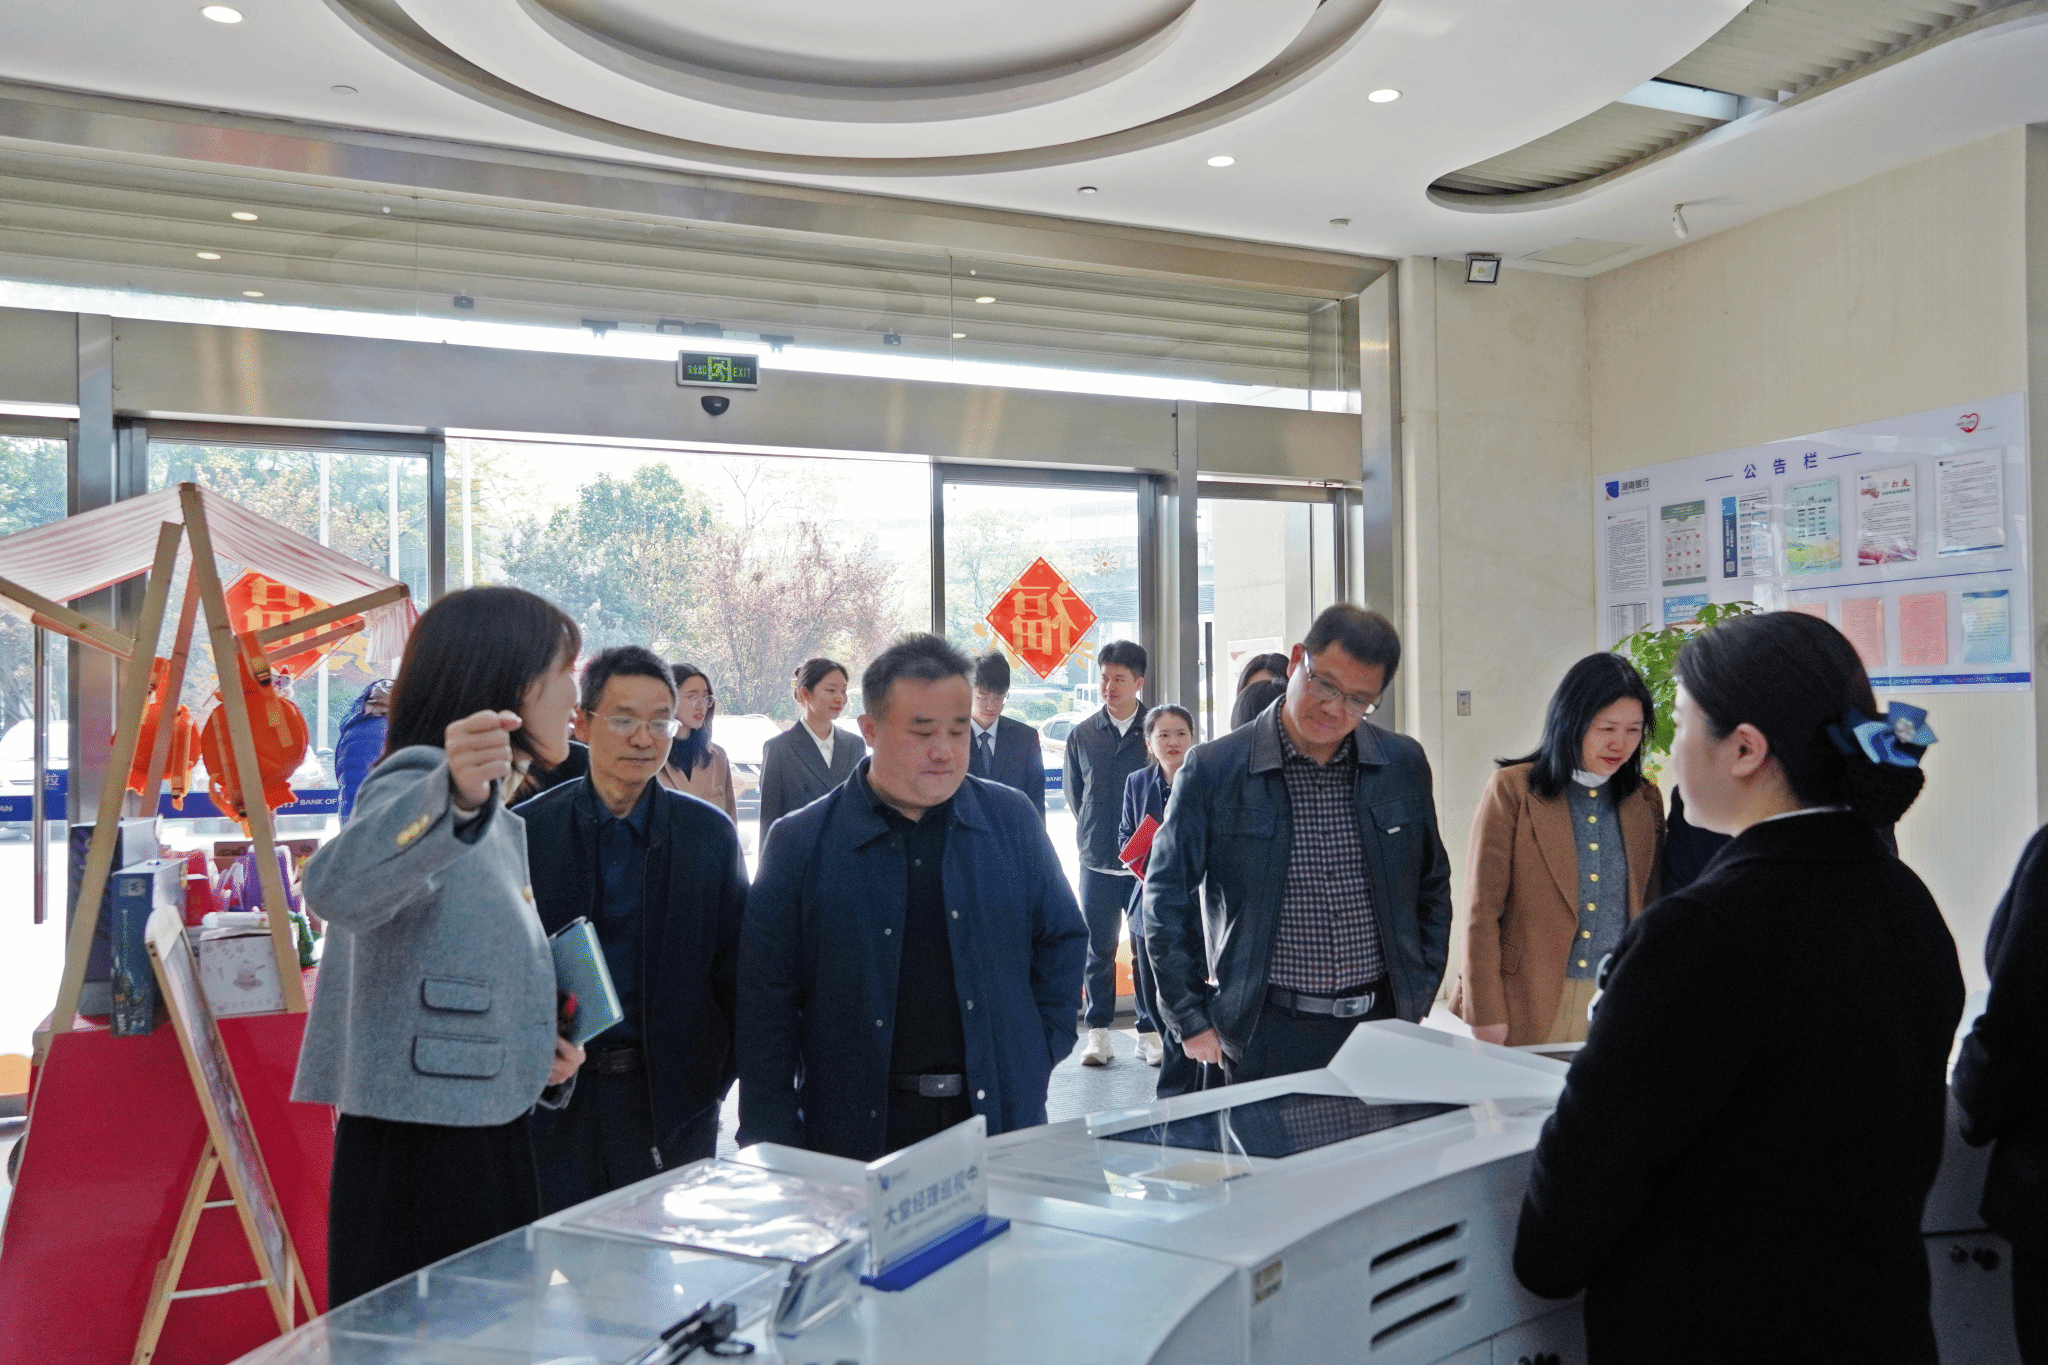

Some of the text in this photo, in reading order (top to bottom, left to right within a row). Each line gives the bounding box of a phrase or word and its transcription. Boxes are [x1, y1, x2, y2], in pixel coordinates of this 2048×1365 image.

[733, 367, 751, 378] EXIT
[1743, 451, 1819, 479] 公告栏
